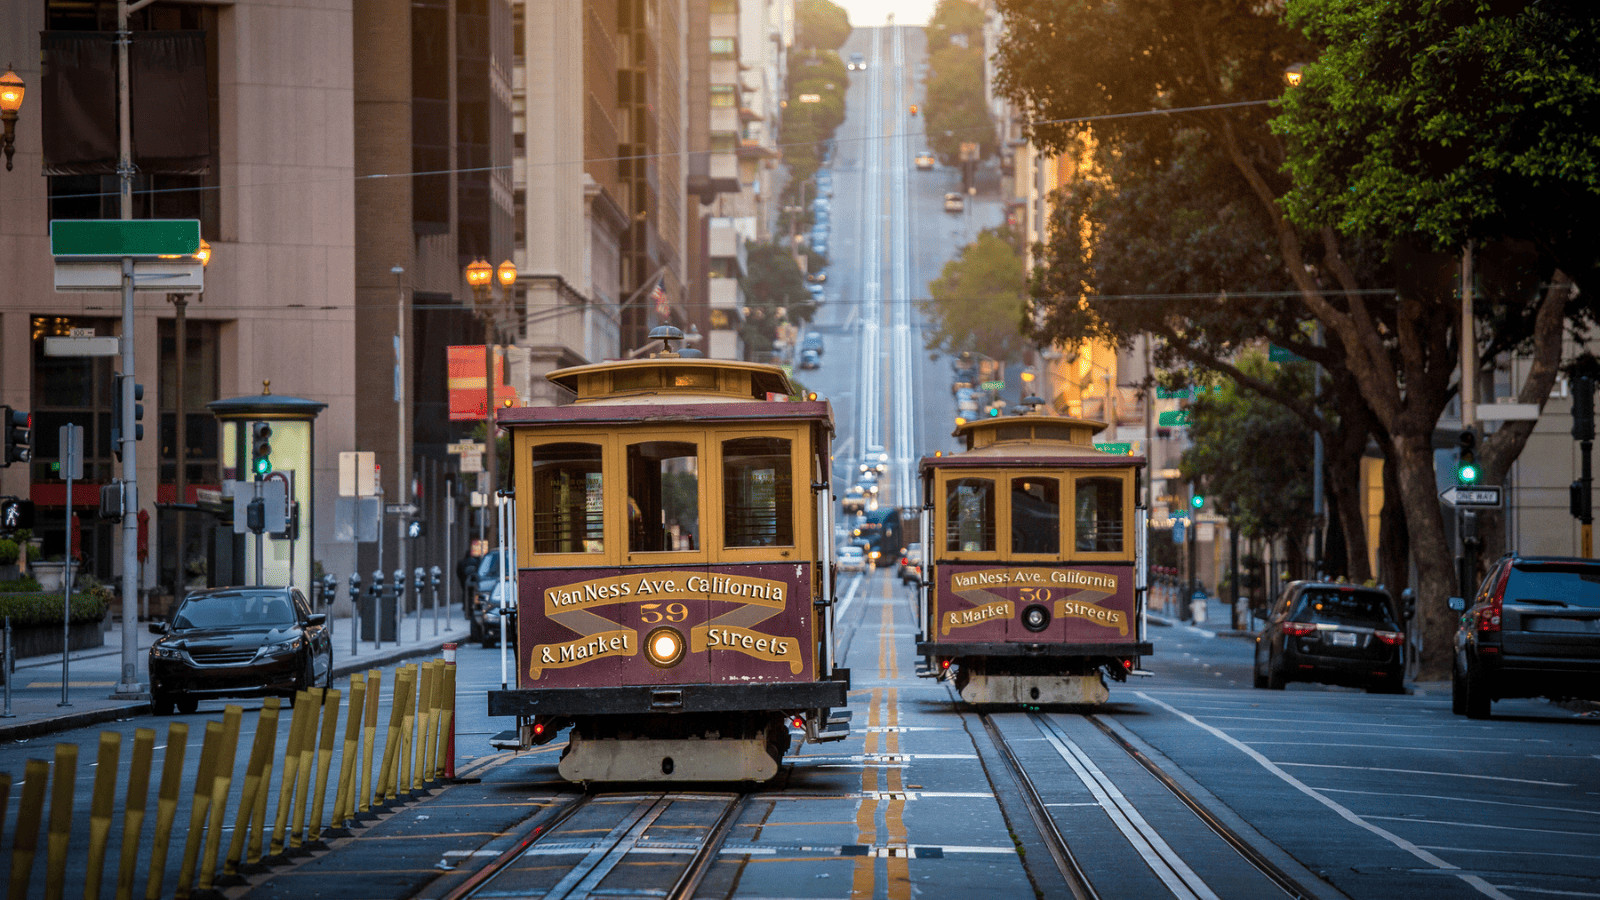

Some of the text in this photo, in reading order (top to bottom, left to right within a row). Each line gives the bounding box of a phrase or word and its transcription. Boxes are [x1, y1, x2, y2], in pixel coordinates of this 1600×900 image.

[1457, 491, 1494, 500] ONE WAY
[687, 576, 783, 602] California
[1051, 571, 1116, 588] California
[1019, 587, 1052, 602] 50
[640, 602, 689, 624] 59
[950, 603, 1009, 625] & Market
[1065, 602, 1120, 623] Streets
[542, 633, 629, 664] & Market
[707, 628, 789, 655] Streets
